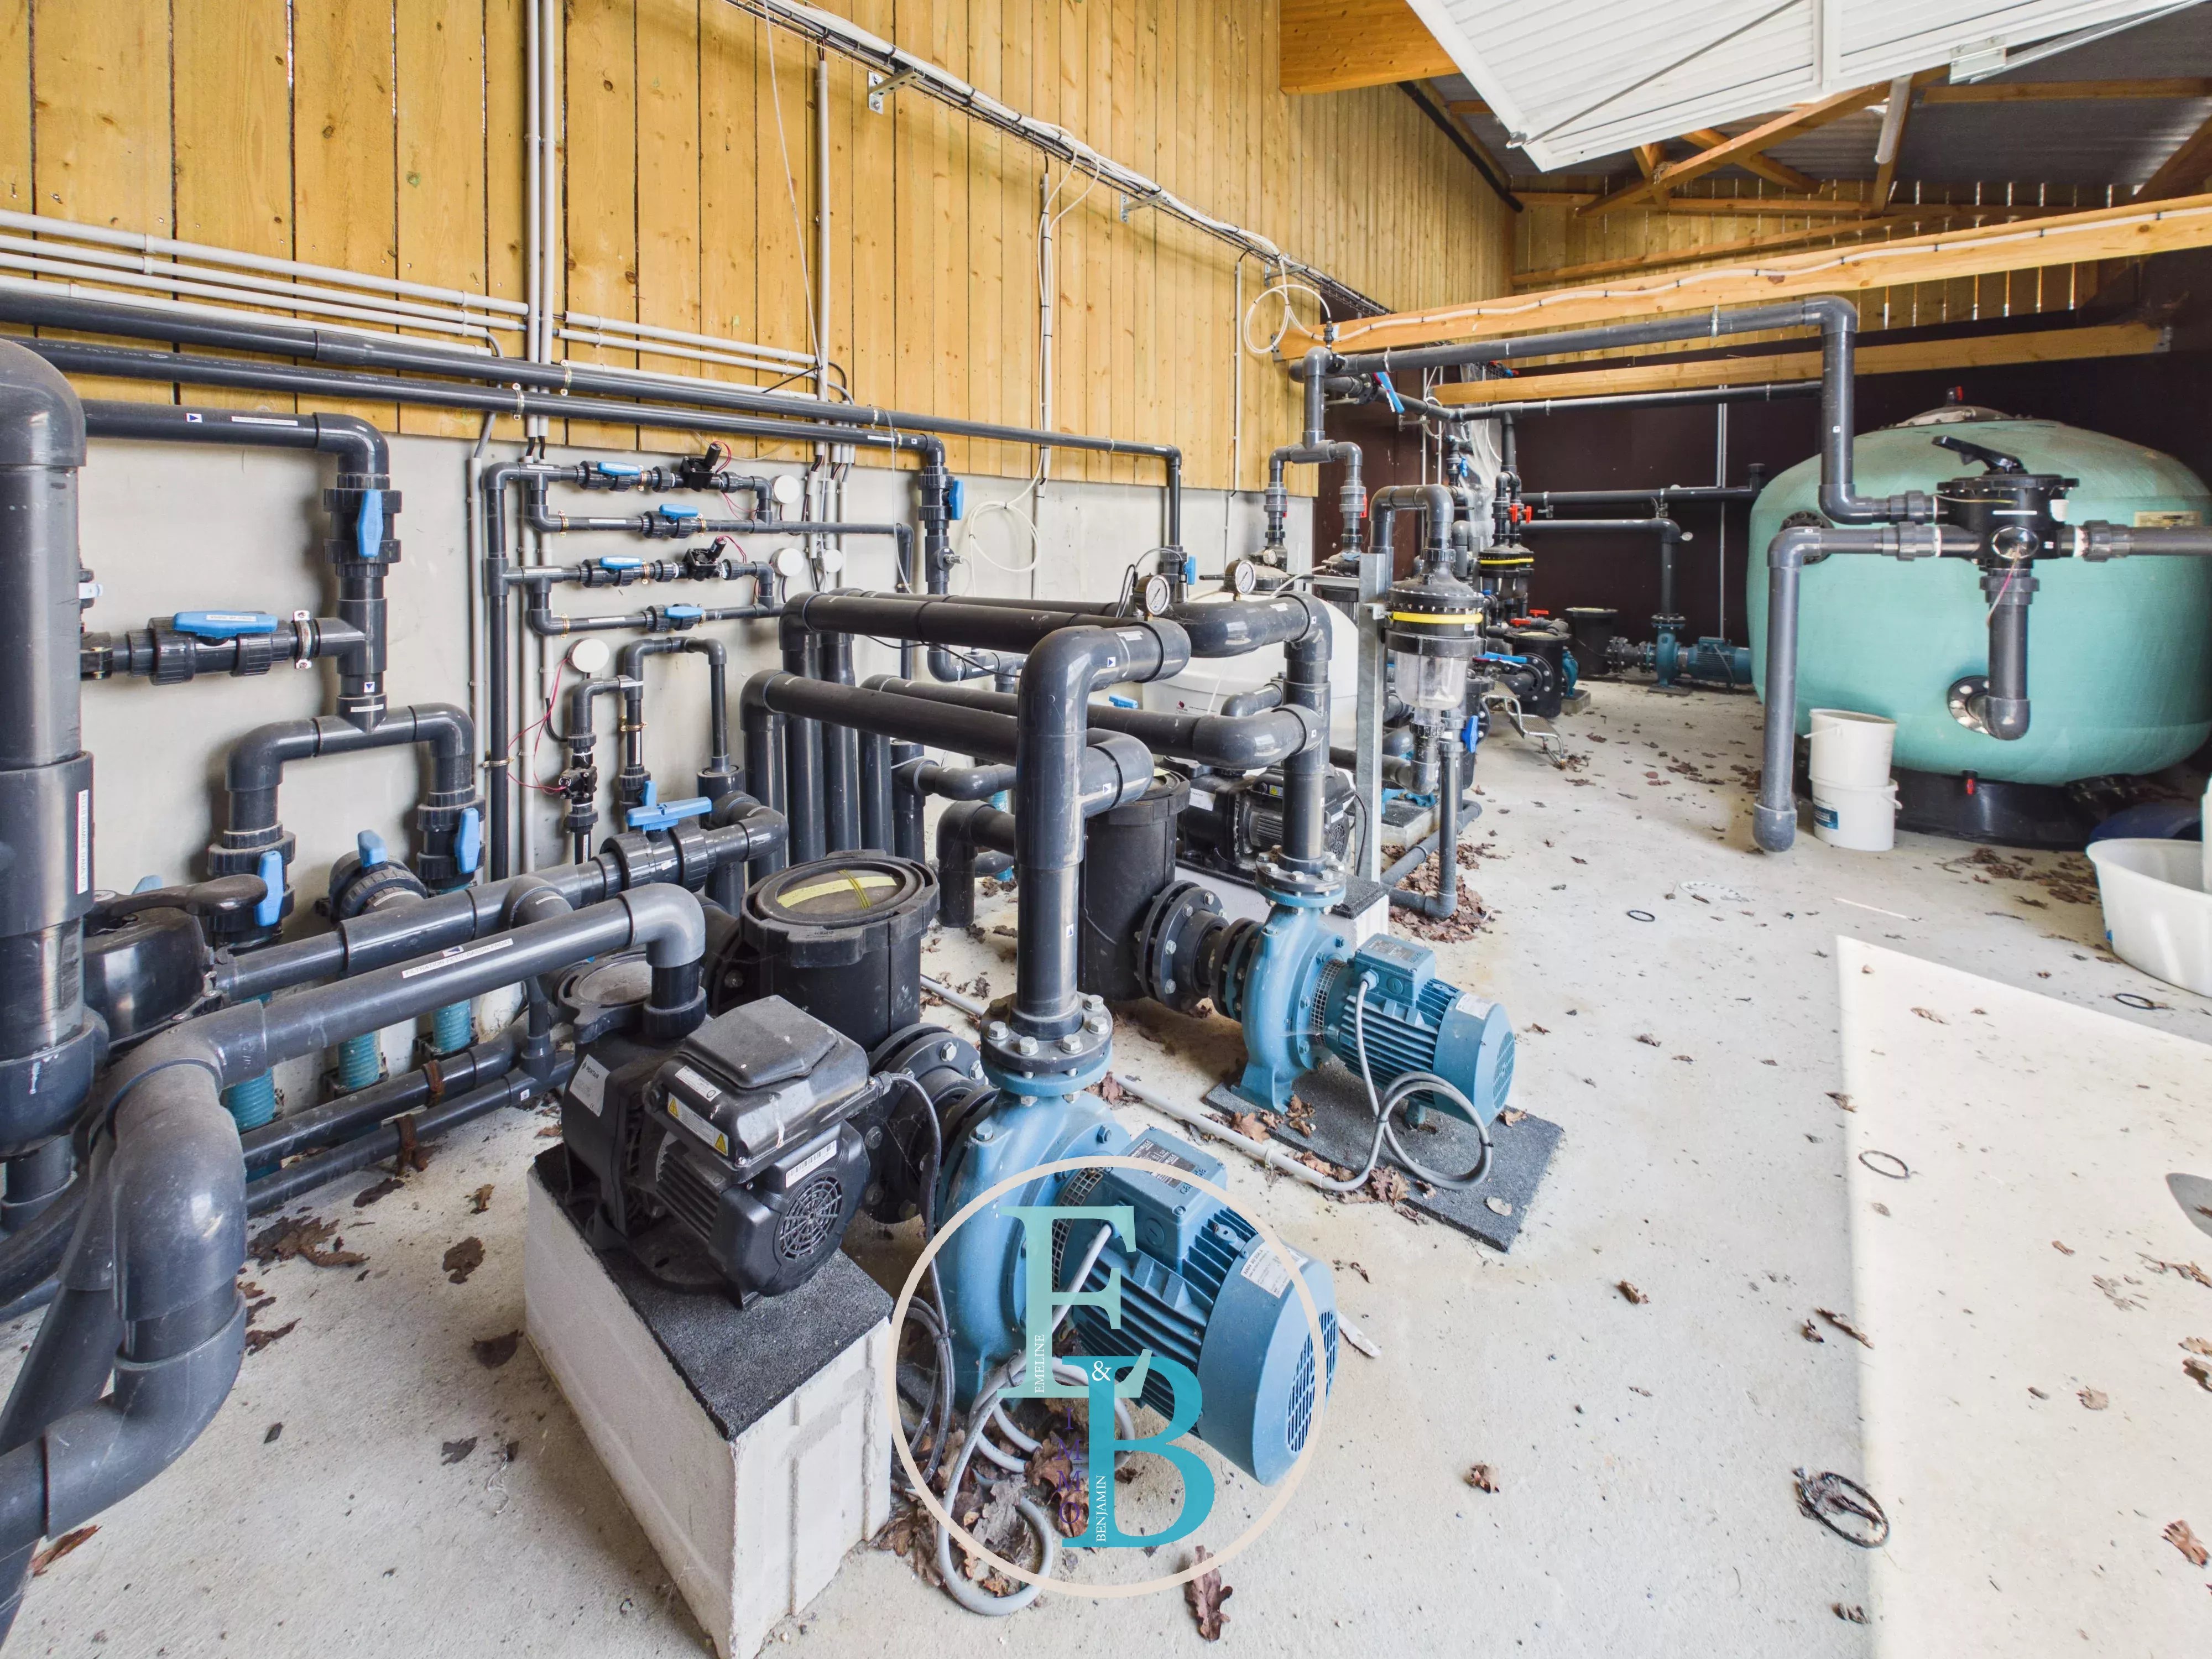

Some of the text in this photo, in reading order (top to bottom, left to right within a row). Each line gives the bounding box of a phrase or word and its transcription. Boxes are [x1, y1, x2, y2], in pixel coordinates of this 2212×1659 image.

[405, 958, 445, 975] FILTRATION
[446, 954, 465, 964] PETIT
[466, 946, 490, 957] BASSIN
